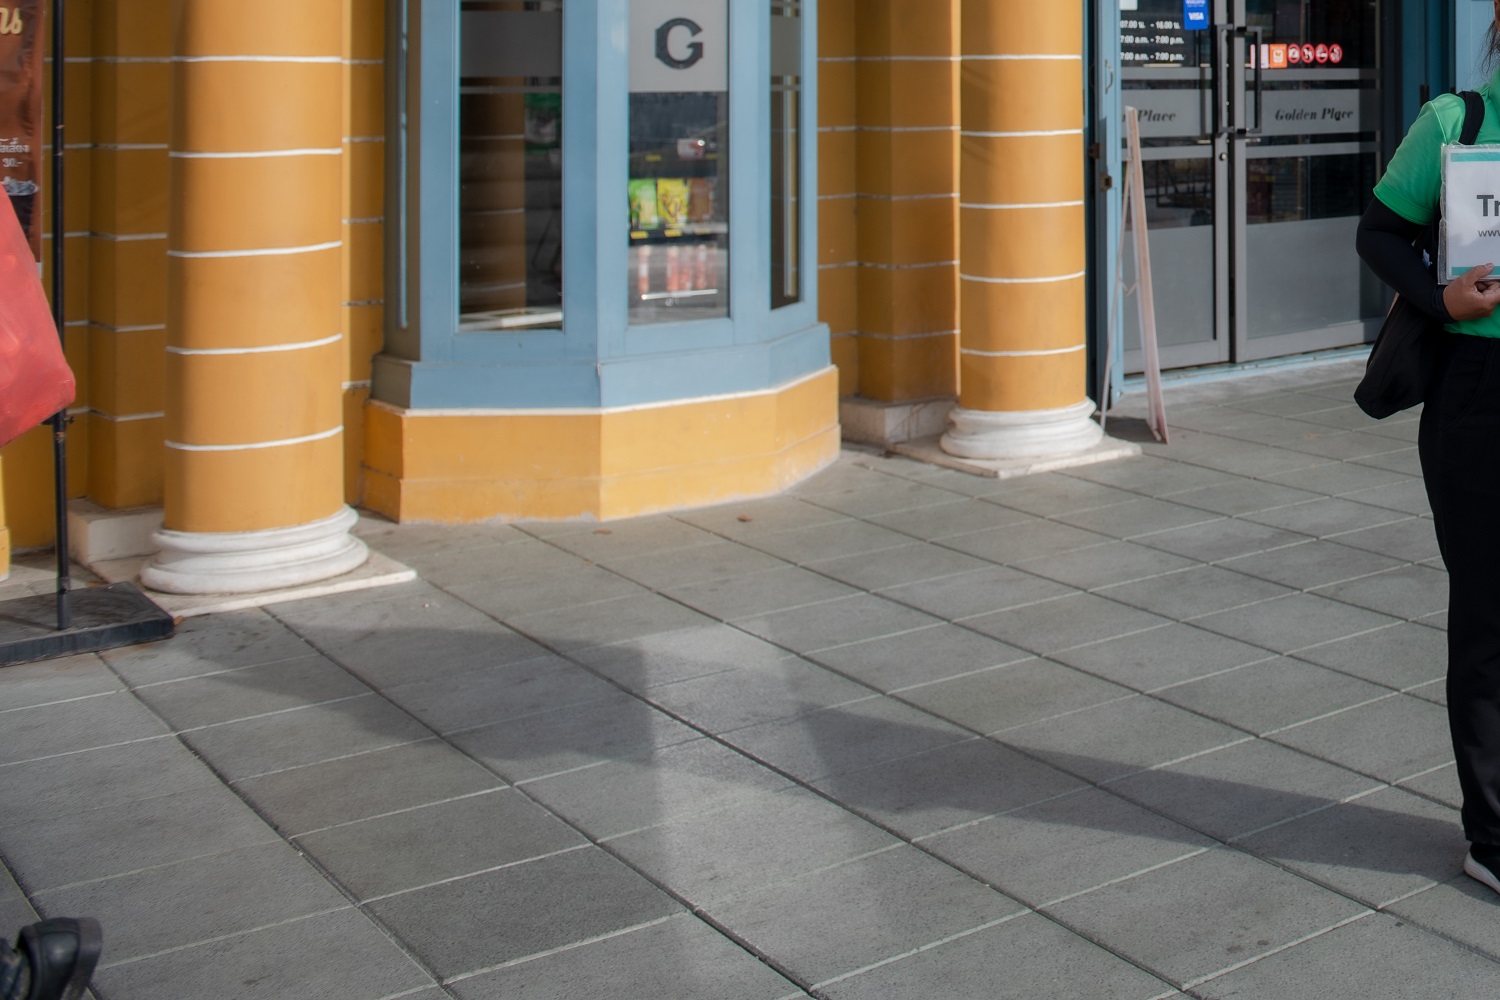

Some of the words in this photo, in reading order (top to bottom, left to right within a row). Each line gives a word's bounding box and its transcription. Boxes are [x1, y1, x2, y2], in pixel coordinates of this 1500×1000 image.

[1188, 12, 1204, 20] VISA
[655, 17, 703, 70] G
[1137, 109, 1176, 122] Place
[1275, 107, 1317, 121] Golden
[1321, 107, 1354, 121] Place
